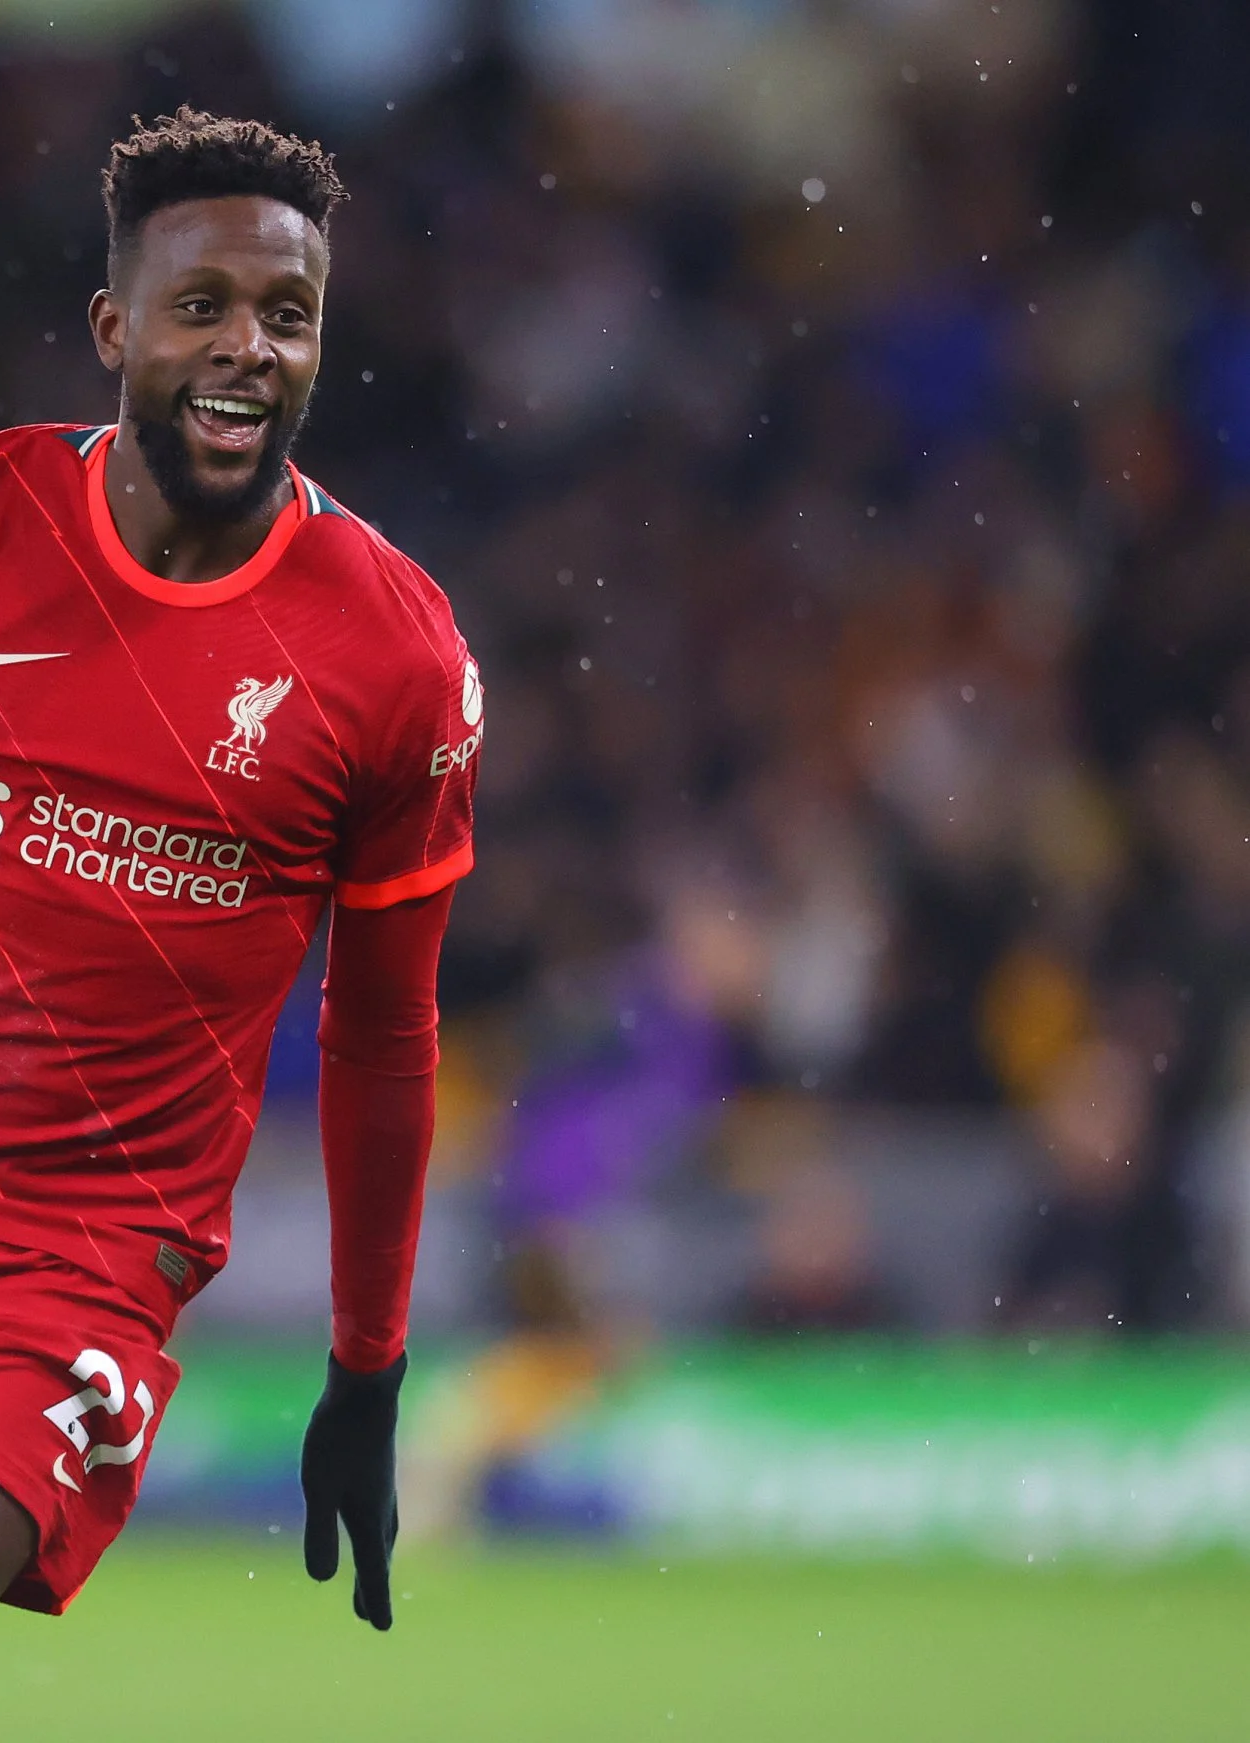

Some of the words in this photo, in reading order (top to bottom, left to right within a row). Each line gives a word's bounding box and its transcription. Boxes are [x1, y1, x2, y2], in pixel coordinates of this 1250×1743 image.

[205, 746, 261, 782] L.F.C.
[19, 832, 249, 908] chartered
[29, 793, 248, 871] standard
